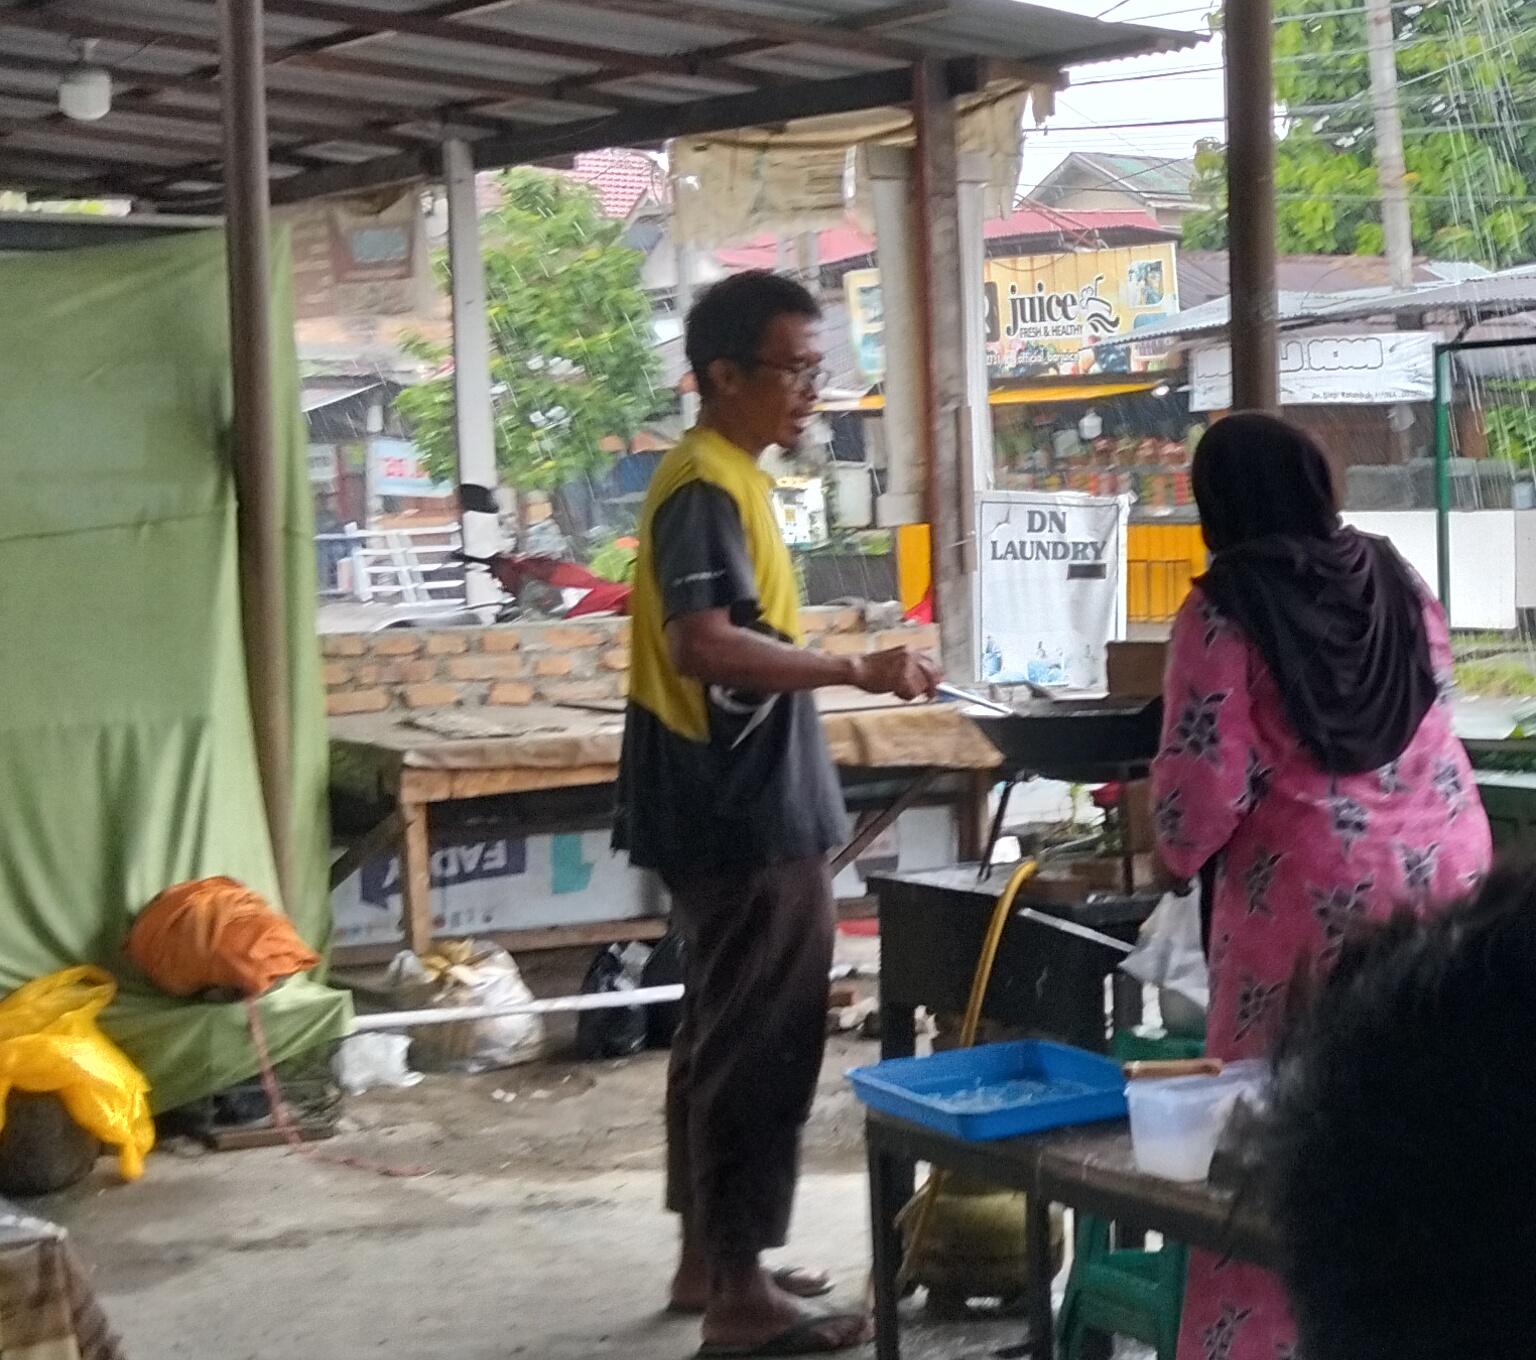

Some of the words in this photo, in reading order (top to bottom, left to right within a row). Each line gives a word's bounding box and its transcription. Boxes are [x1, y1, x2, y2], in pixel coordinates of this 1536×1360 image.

[1006, 282, 1078, 337] juice
[1020, 327, 1042, 338] FRESH
[1043, 326, 1050, 337] &
[1051, 324, 1083, 337] HEALTHY
[1027, 510, 1067, 534] DN
[991, 540, 1107, 560] LAUNDRY
